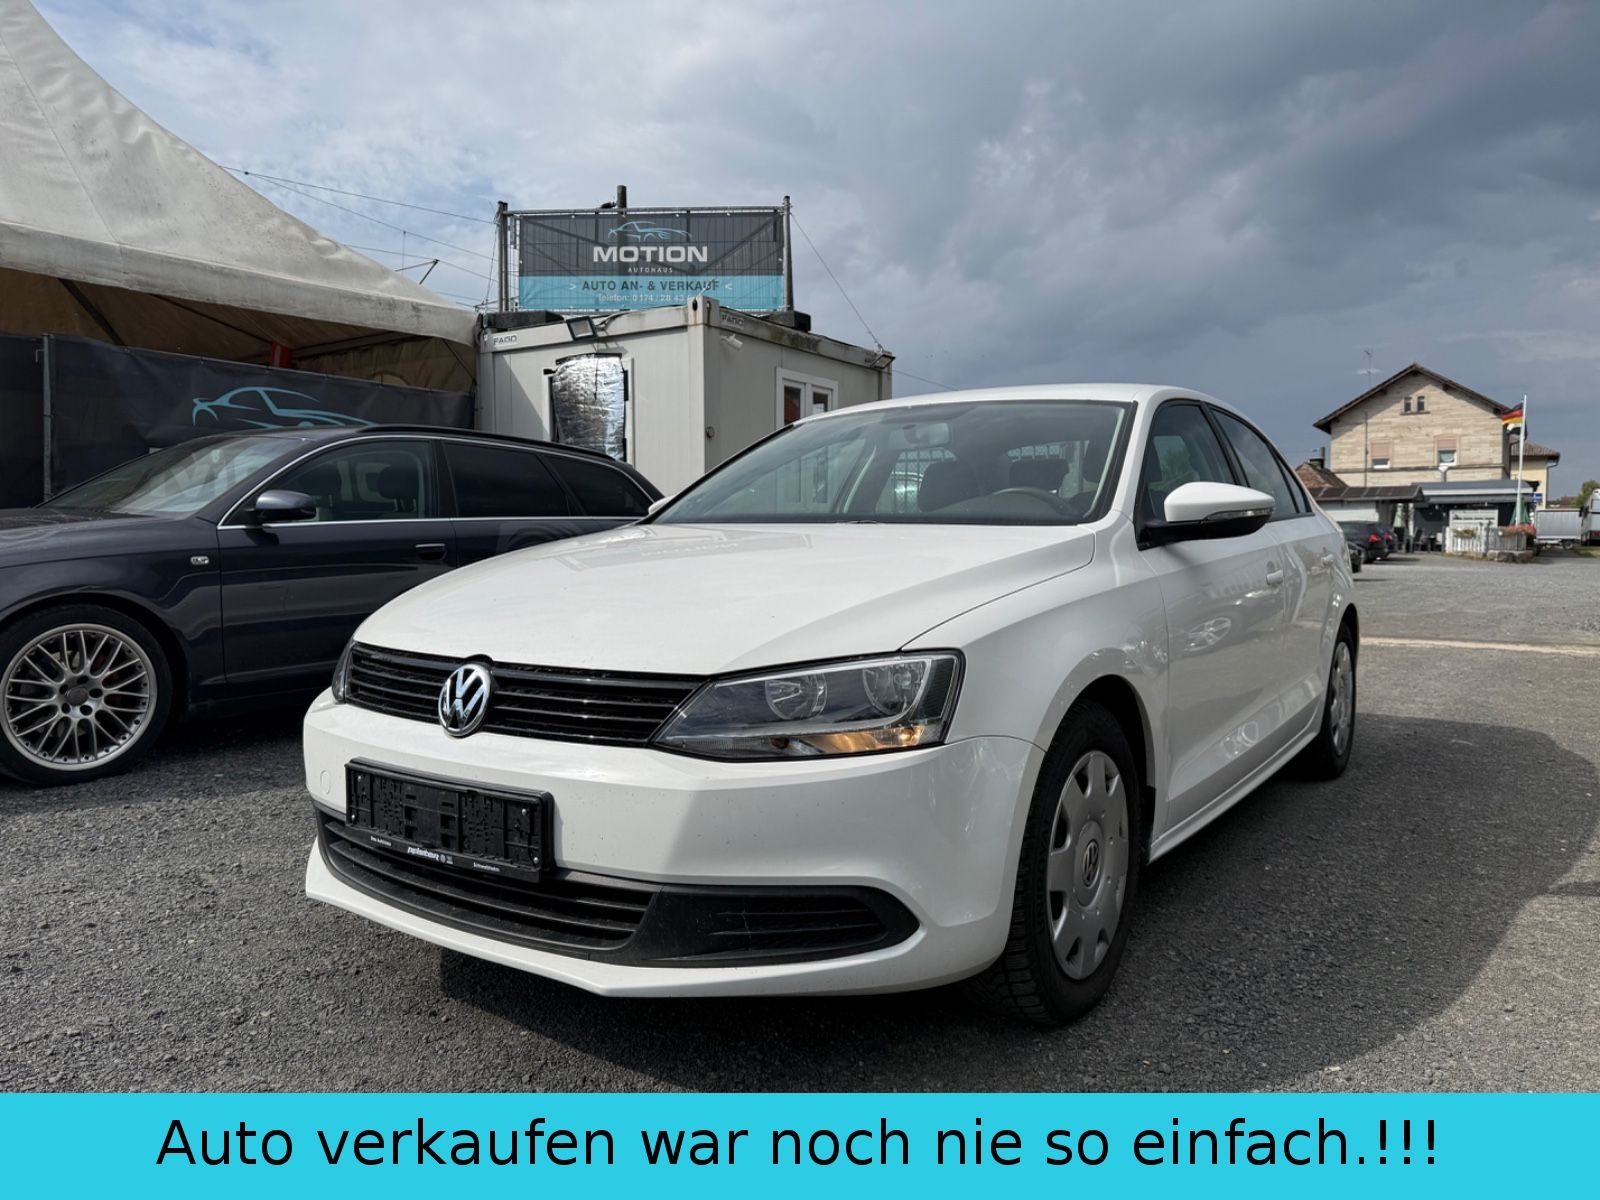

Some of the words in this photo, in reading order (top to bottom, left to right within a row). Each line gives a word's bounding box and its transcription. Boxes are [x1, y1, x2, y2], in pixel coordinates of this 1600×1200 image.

[593, 246, 708, 263] MOTION
[582, 280, 617, 291] AUTO
[620, 280, 643, 291] AN-
[647, 280, 656, 291] &
[659, 280, 720, 291] VERKAUF
[438, 663, 491, 736] VW
